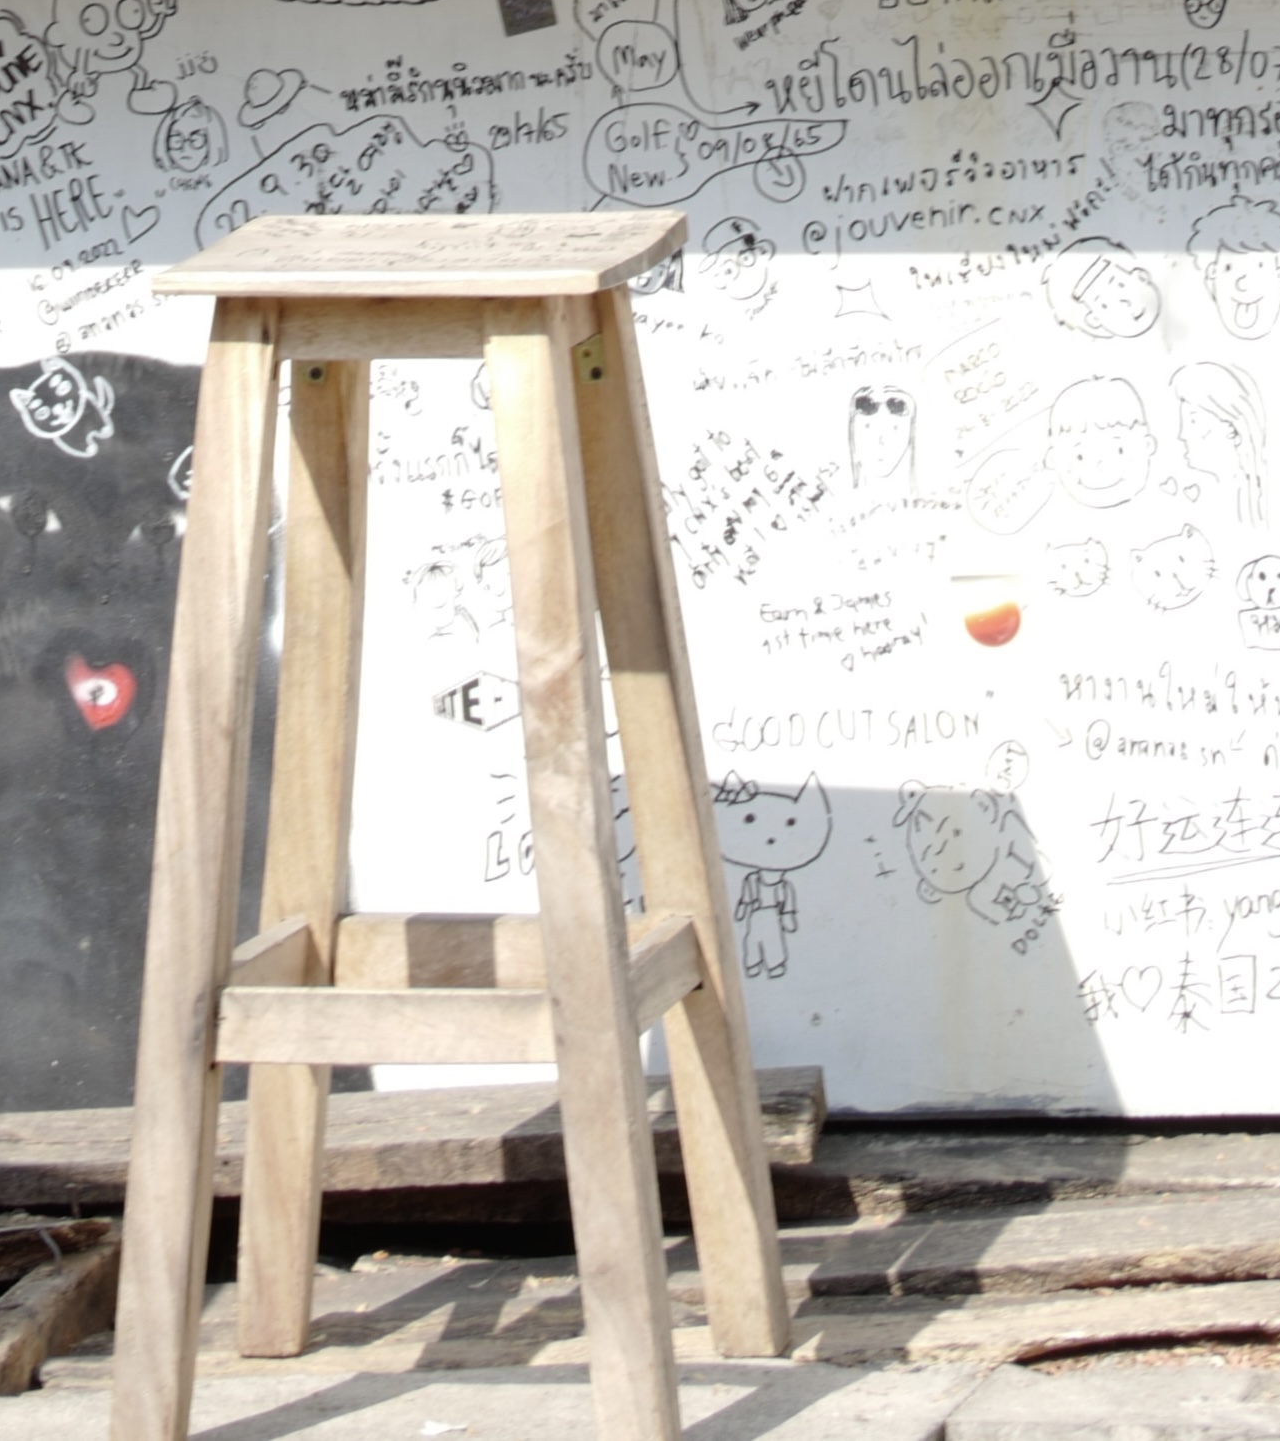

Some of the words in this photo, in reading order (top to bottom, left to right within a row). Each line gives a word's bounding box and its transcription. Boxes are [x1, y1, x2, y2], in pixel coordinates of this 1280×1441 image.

[611, 44, 667, 84] May
[605, 116, 672, 155] Golf
[817, 708, 873, 749] CUT
[1168, 950, 1257, 1034] 泰国
